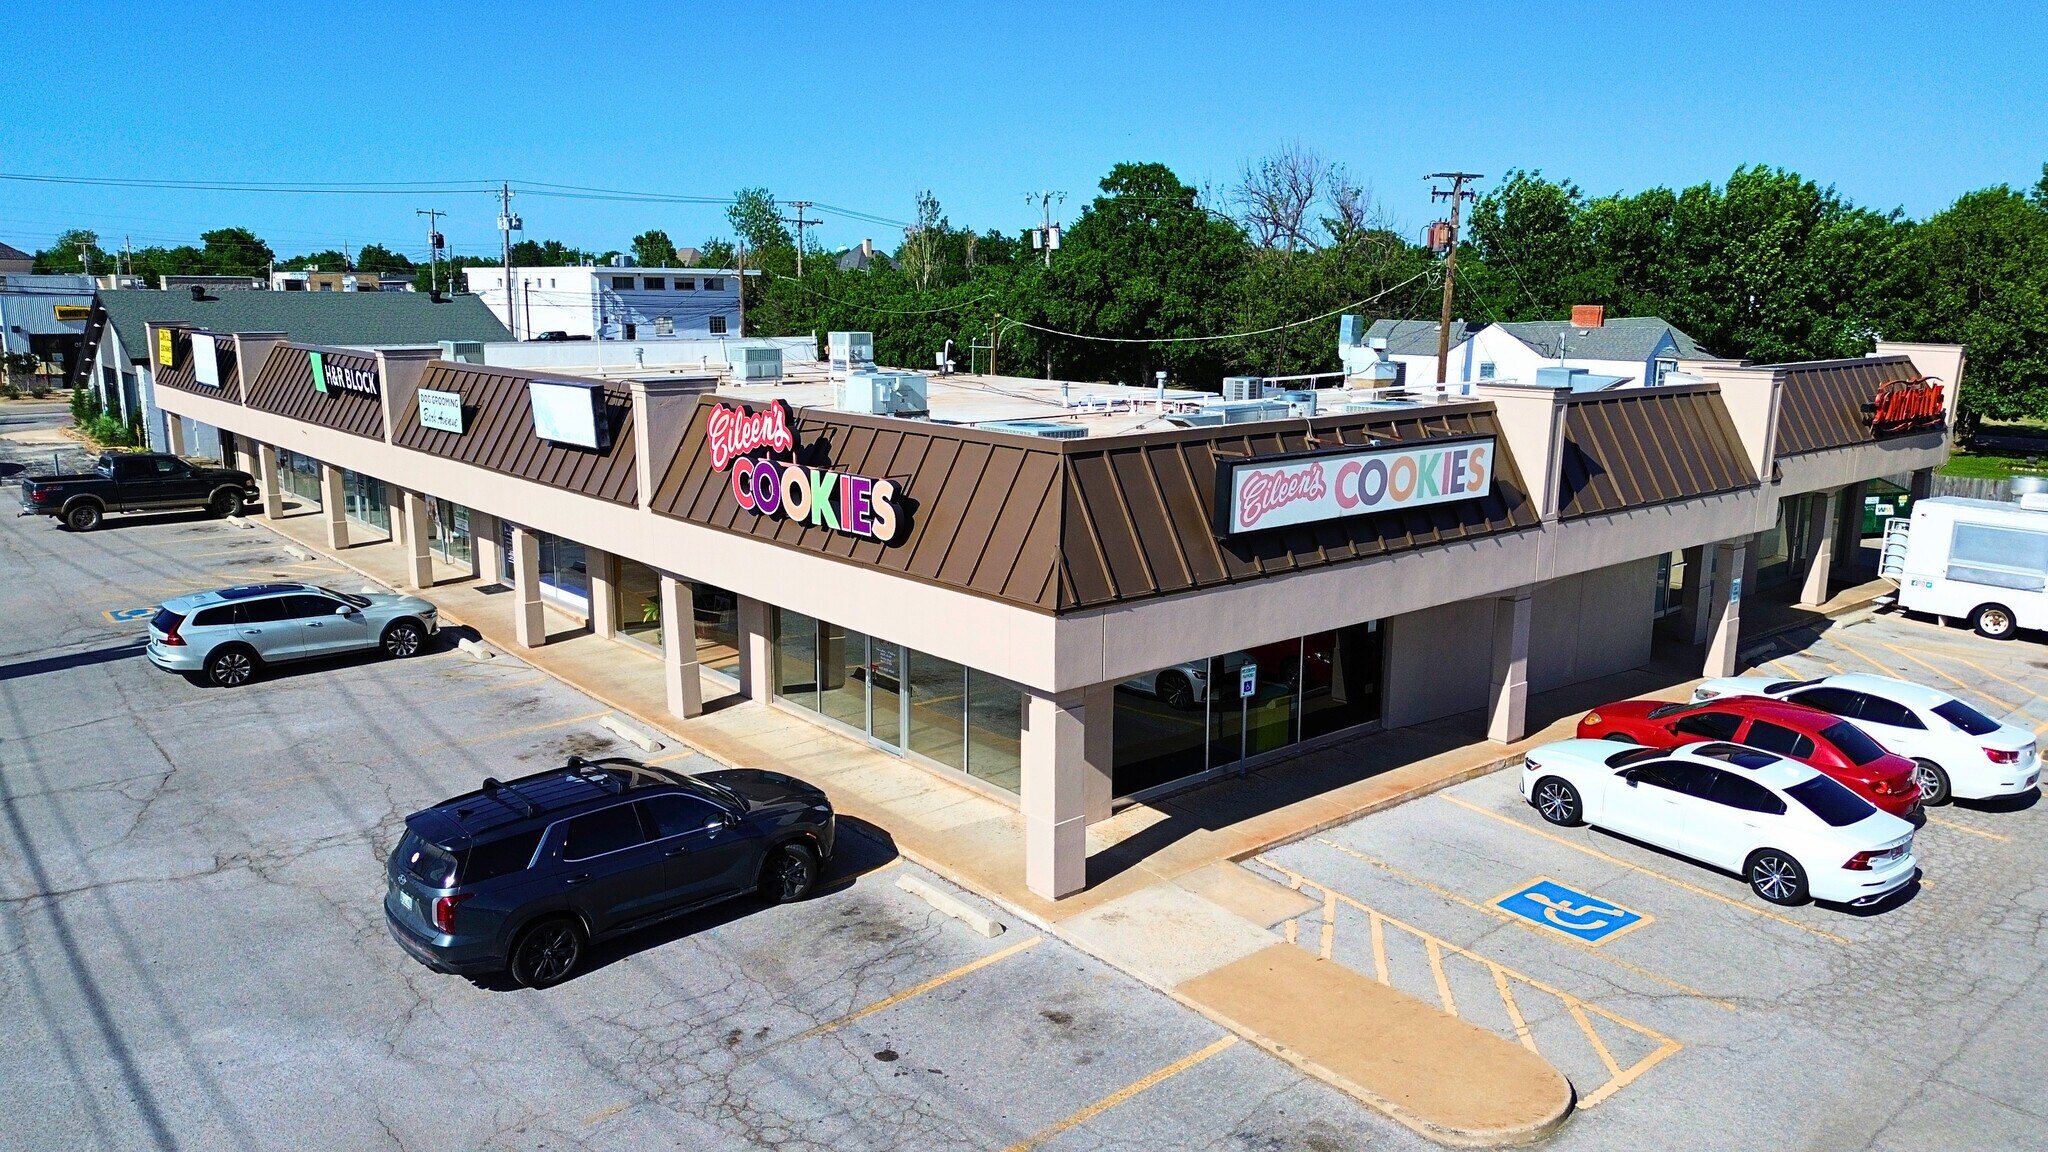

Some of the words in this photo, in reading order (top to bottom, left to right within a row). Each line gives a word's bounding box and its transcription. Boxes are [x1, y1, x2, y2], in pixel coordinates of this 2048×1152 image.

[325, 364, 346, 388] H&R
[343, 367, 378, 395] BLOCK
[708, 400, 793, 472] Eileen's
[732, 456, 896, 541] COOKIES
[1240, 463, 1327, 527] Eileen's
[1335, 446, 1485, 509] COOKIES
